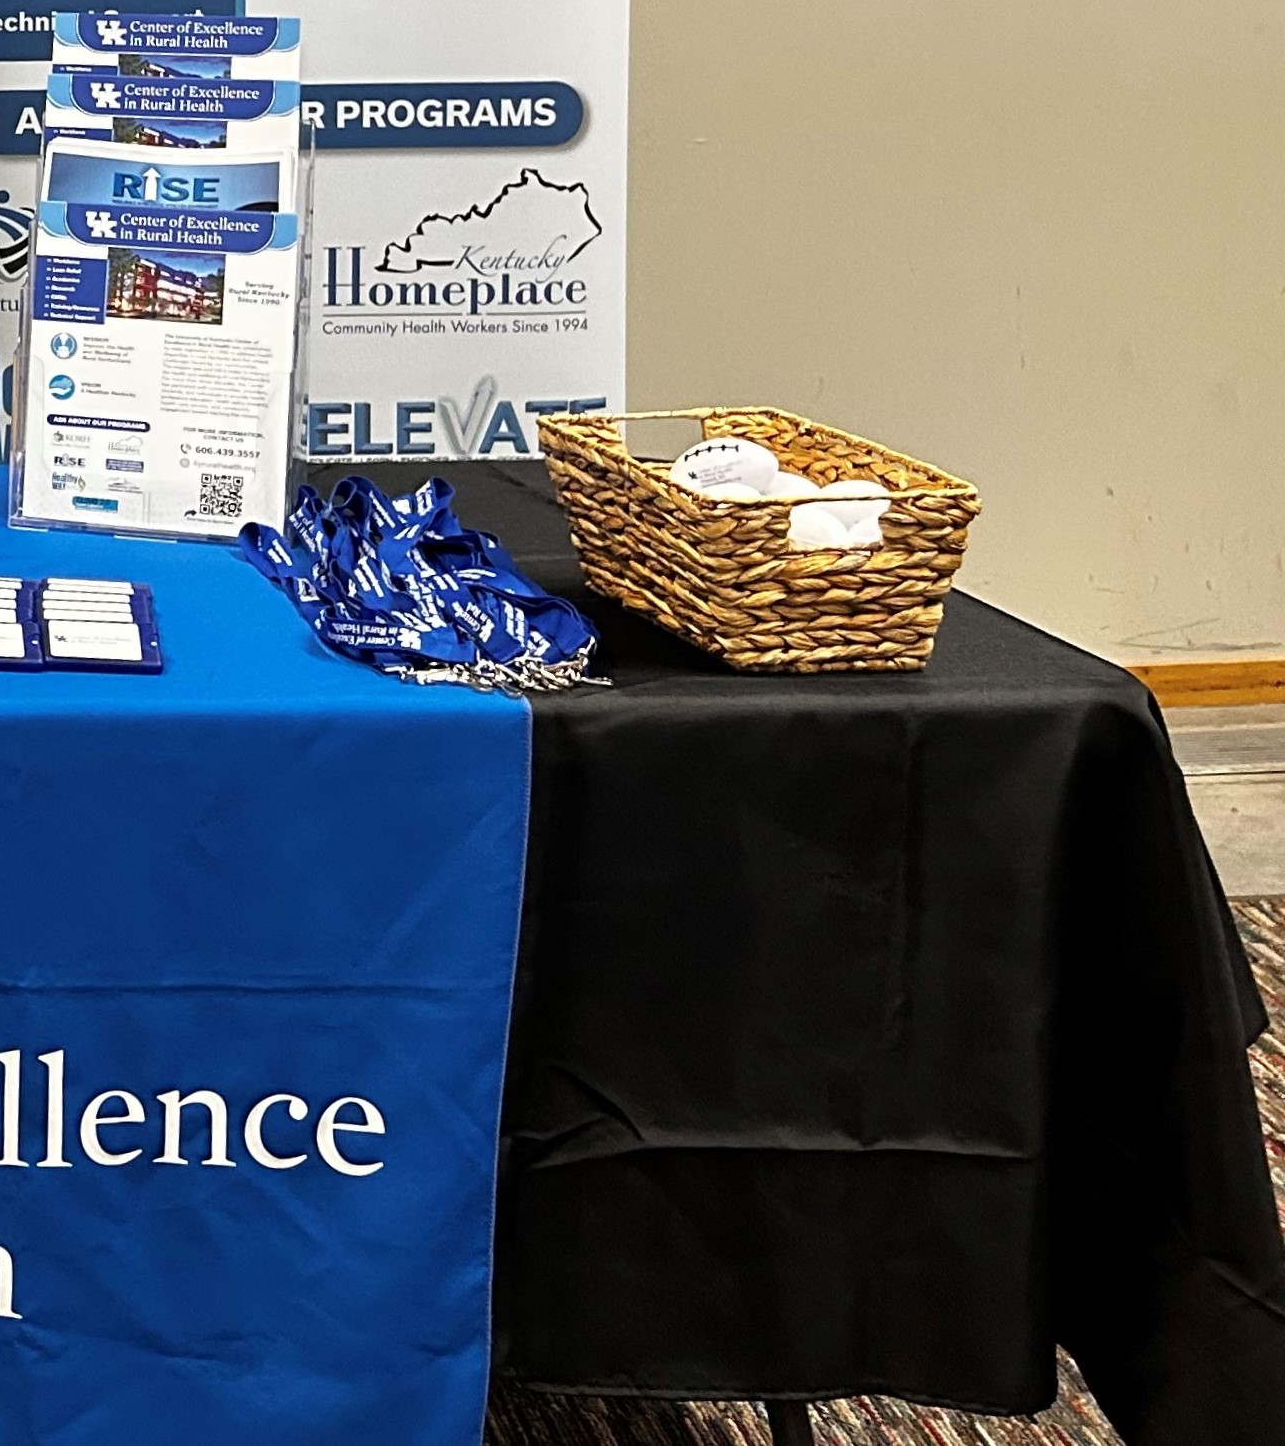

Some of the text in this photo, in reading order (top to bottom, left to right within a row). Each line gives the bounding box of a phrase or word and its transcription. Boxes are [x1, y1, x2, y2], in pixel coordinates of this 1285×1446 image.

[130, 21, 263, 35] Center of Excellence
[130, 35, 227, 48] in Rural Health
[125, 84, 259, 99] Center of Excellence
[125, 98, 223, 112] in Rural Health
[337, 98, 556, 128] PROGRAMS
[112, 166, 220, 203] RISE
[121, 213, 259, 232] Center of Excellence
[121, 227, 222, 244] in Rural Health
[453, 234, 568, 282] Kentucky
[322, 246, 587, 315] Homeplace
[322, 318, 588, 337] Community Health Workers Since 1994
